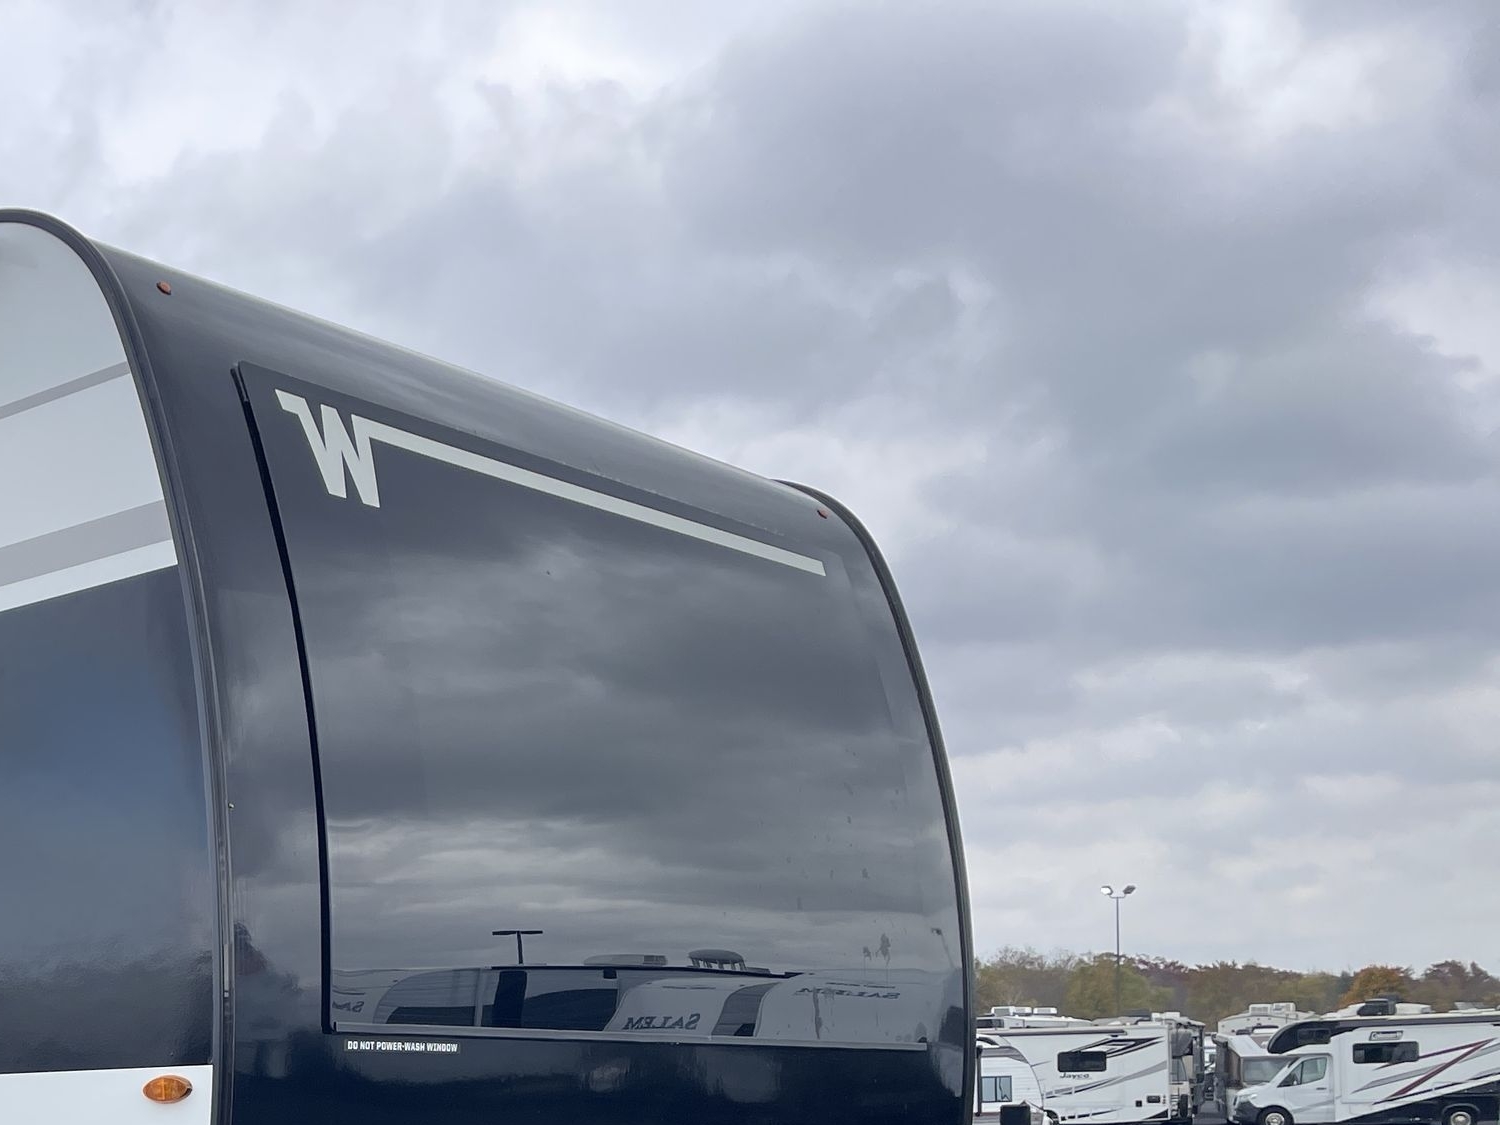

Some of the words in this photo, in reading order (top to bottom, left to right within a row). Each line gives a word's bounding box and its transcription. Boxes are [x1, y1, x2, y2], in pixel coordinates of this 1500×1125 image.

[347, 1041, 359, 1050] DO
[360, 1041, 375, 1050] NOT
[376, 1041, 425, 1052] POWER-WASH
[426, 1042, 458, 1052] WINDOW
